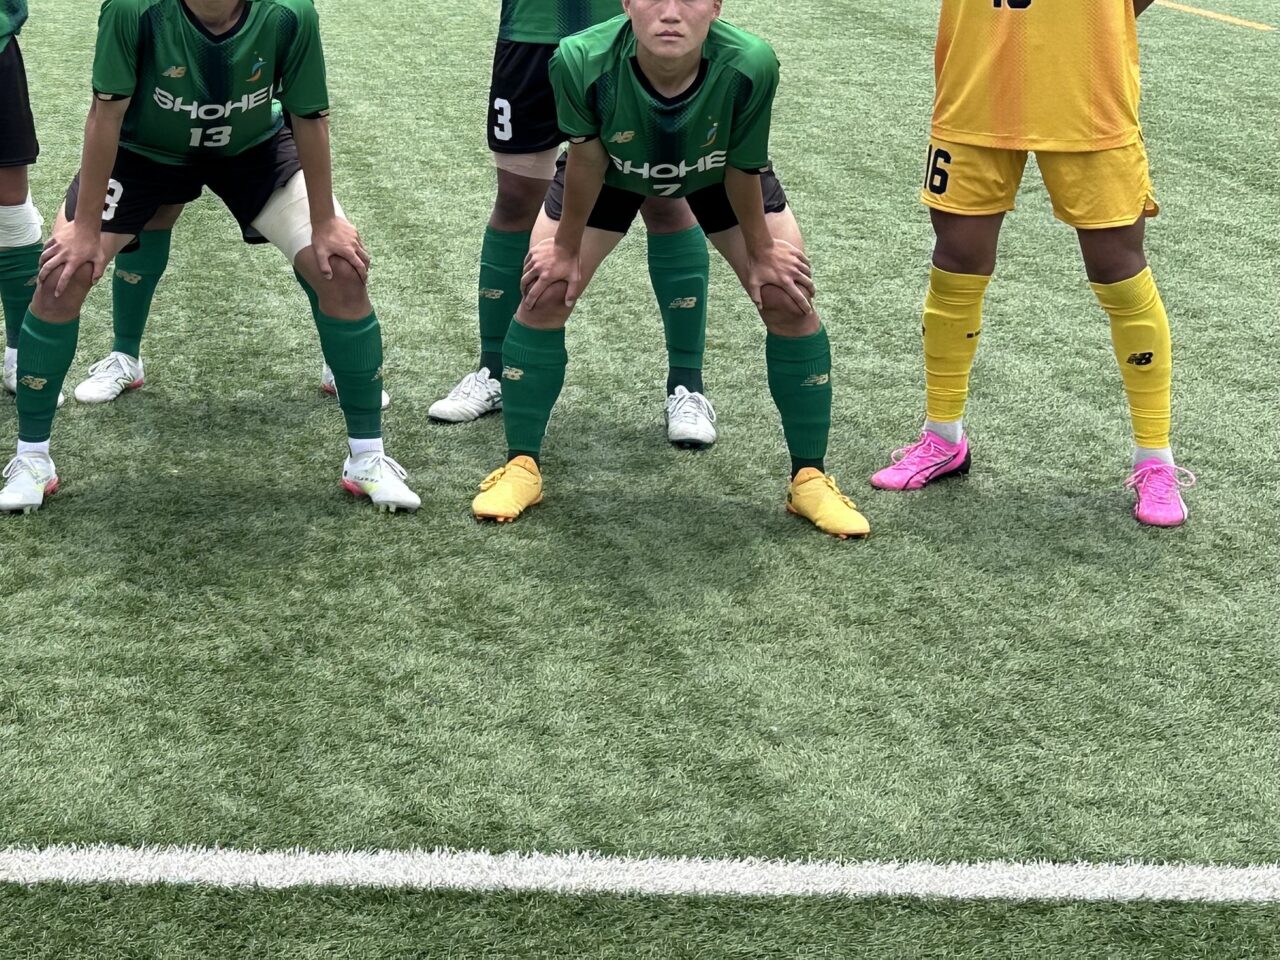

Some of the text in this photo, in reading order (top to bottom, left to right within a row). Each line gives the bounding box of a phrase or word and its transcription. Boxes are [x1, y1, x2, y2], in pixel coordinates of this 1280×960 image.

[494, 96, 513, 141] 3
[189, 125, 233, 148] 13
[609, 150, 727, 179] HOHE
[923, 143, 952, 195] 16
[652, 183, 682, 197] 7
